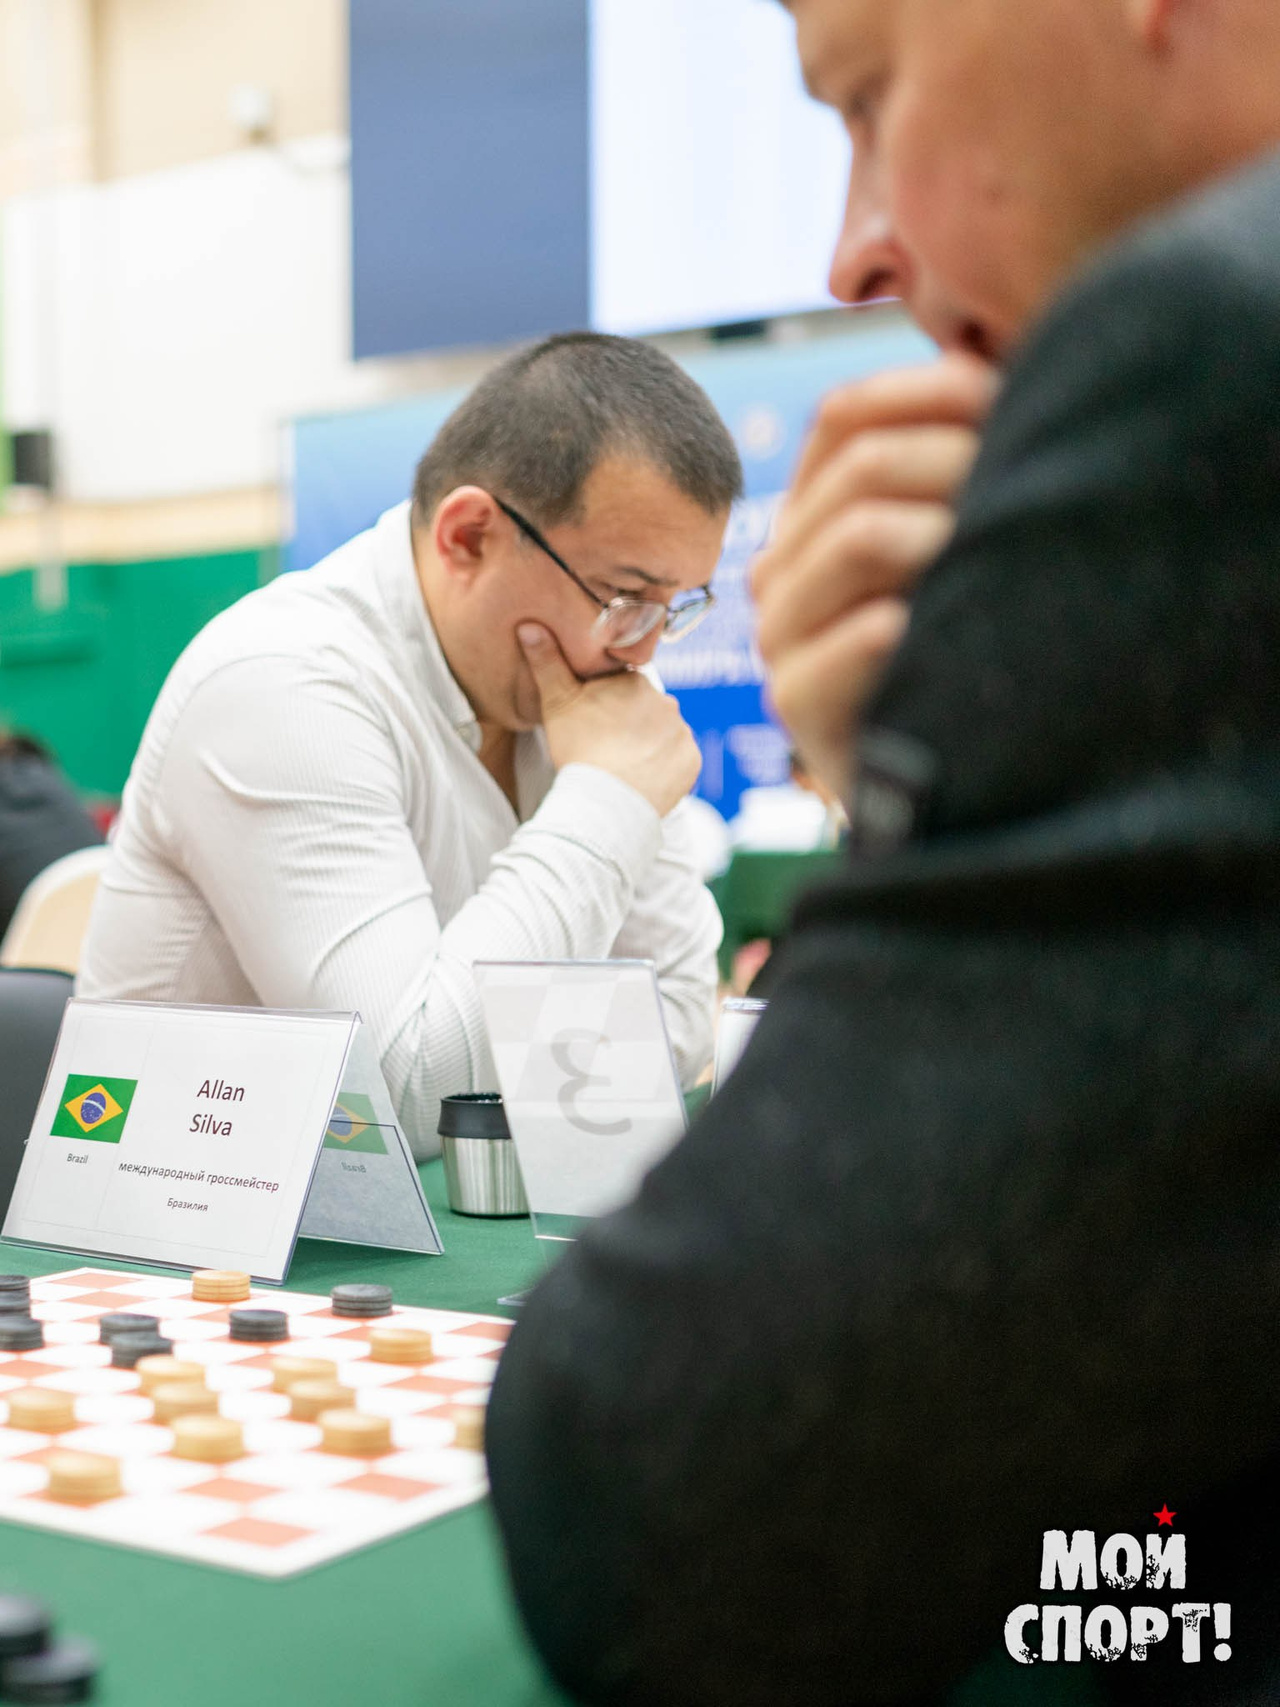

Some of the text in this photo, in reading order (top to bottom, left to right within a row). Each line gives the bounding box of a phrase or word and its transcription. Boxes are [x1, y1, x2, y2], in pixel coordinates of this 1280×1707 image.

[196, 1079, 245, 1102] Allan
[189, 1113, 233, 1136] Silva
[66, 1153, 88, 1164] Brazil
[118, 1161, 280, 1193] международный гроссмейстер
[167, 1197, 208, 1213] Бразилия
